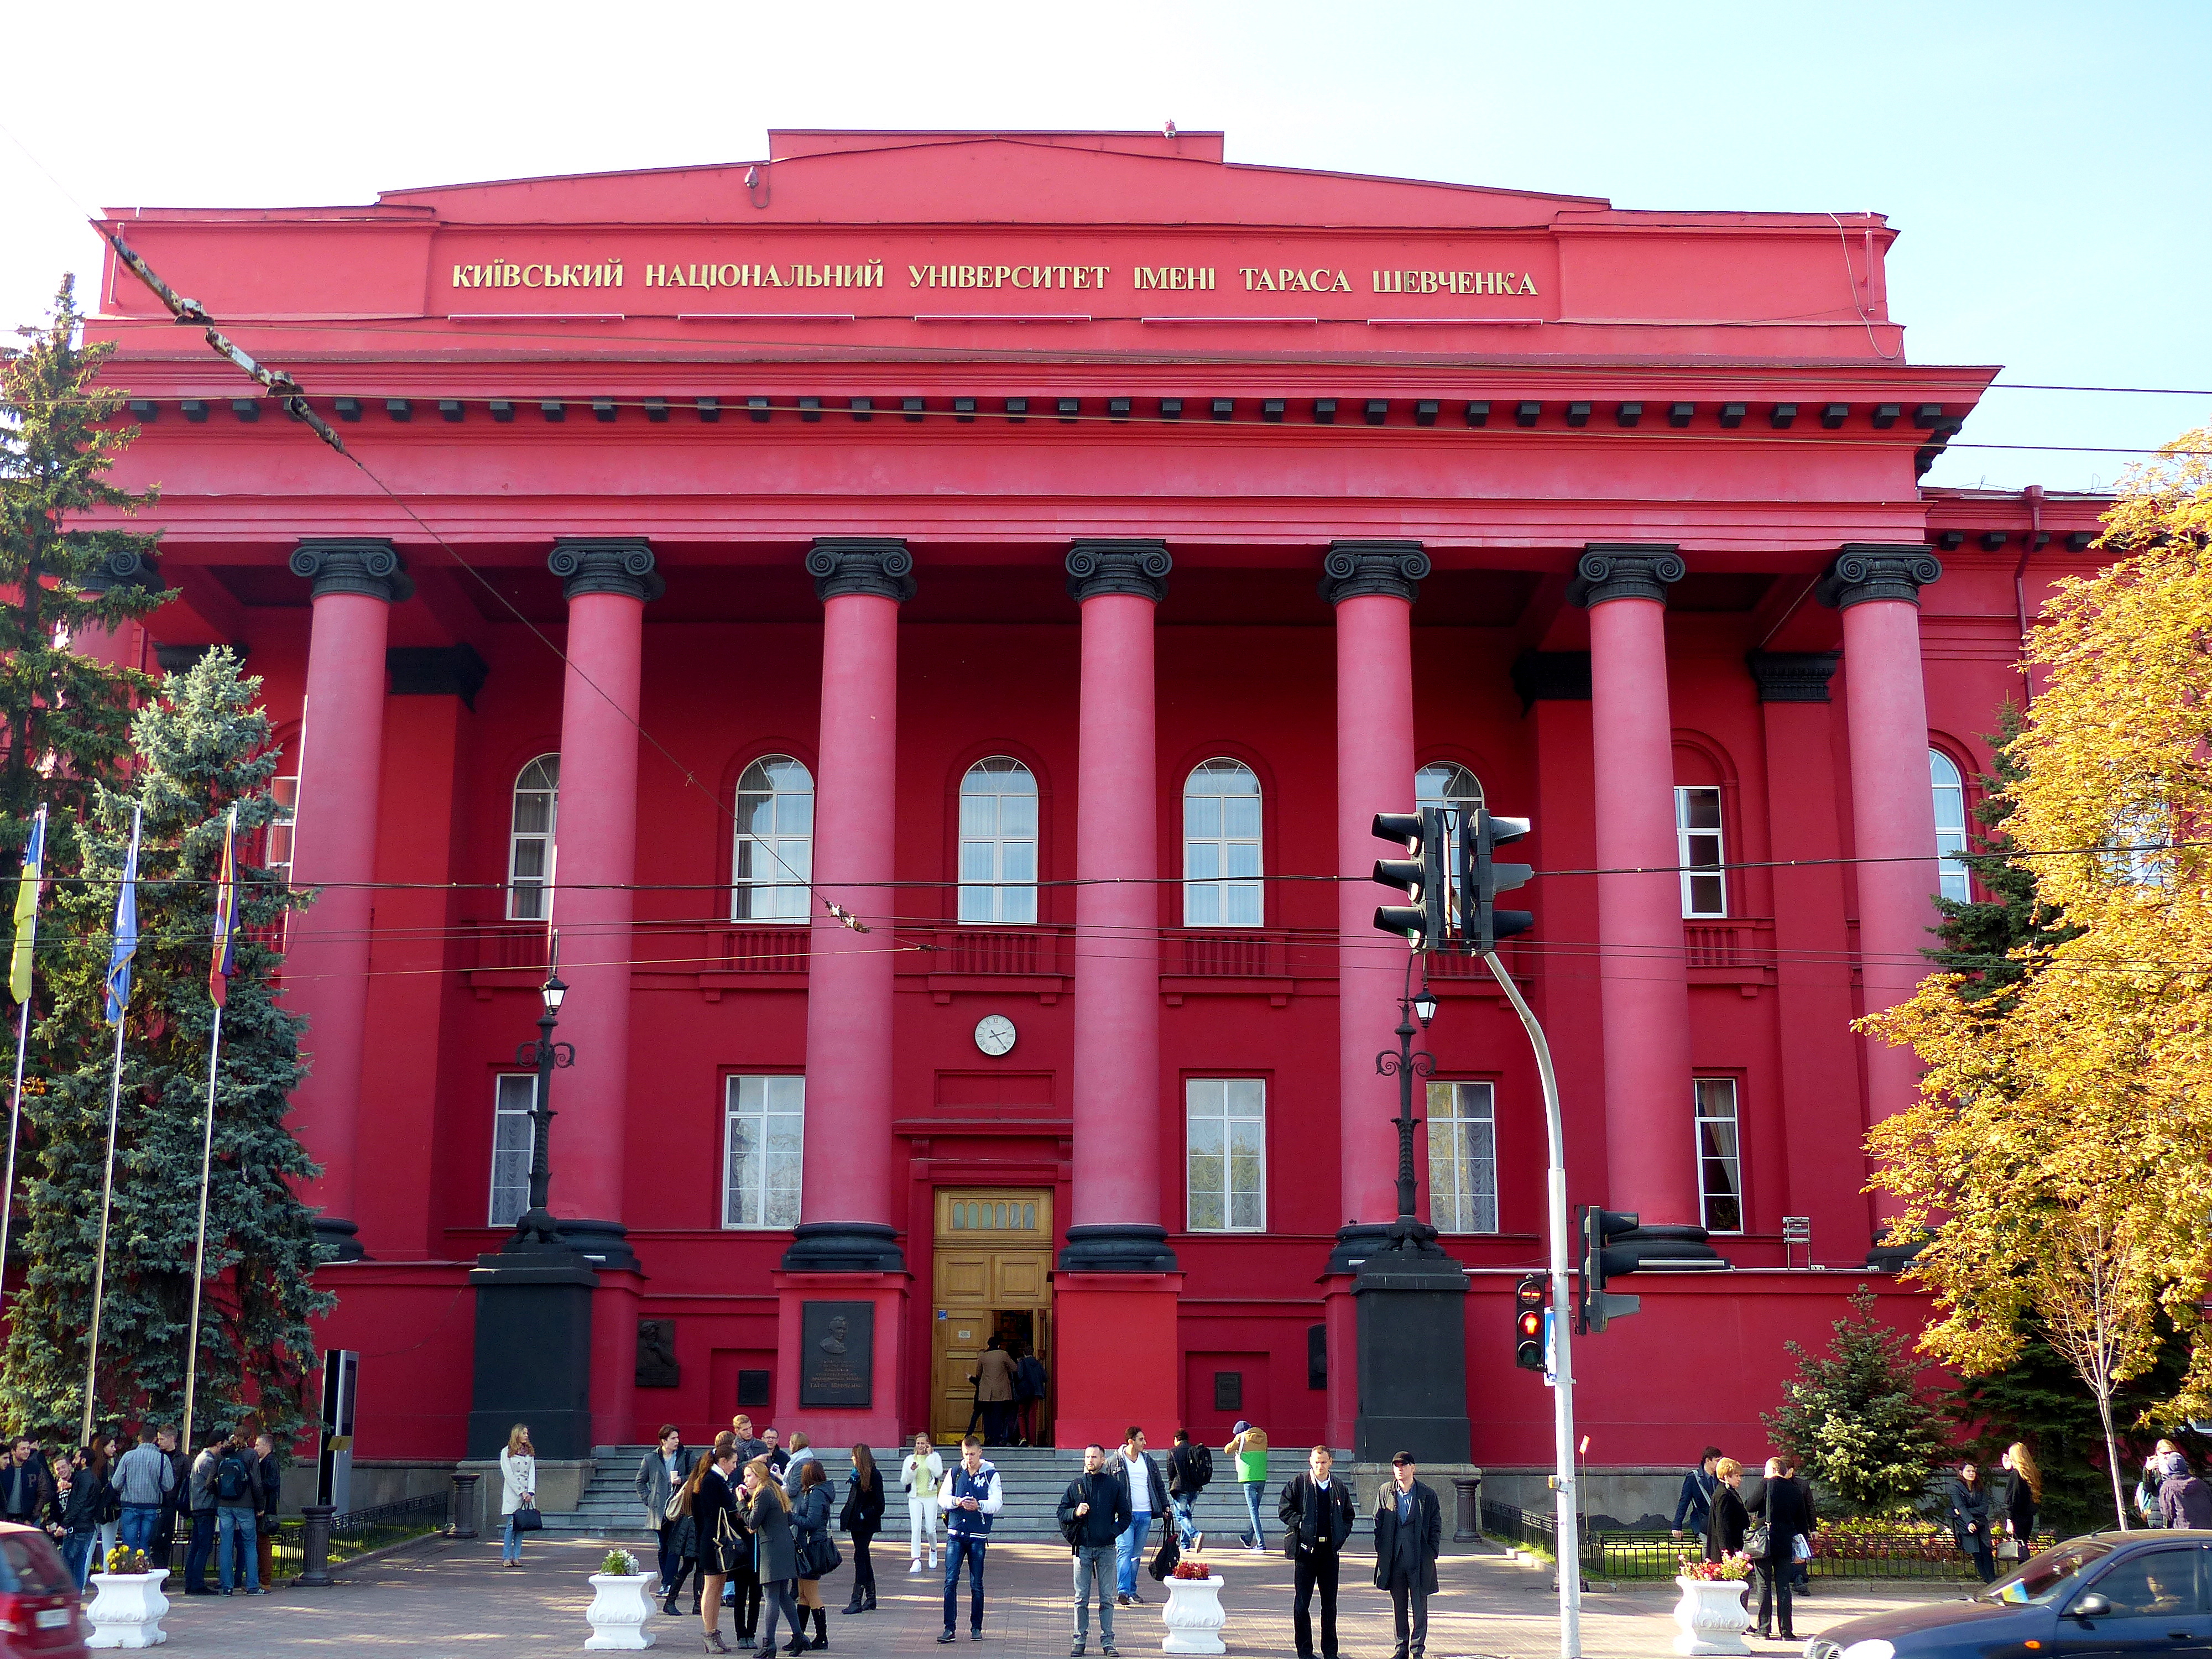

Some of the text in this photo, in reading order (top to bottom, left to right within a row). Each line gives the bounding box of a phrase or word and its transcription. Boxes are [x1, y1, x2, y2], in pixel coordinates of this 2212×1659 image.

[453, 258, 1538, 295] КИЇВСЬКИЙ НАЦІОНАЛЬНИЙ УНІВЕРСИТЕТ ІМЕНІ ТАРАСА ШЕВЧЕНКА
[27, 1473, 36, 1488] P
